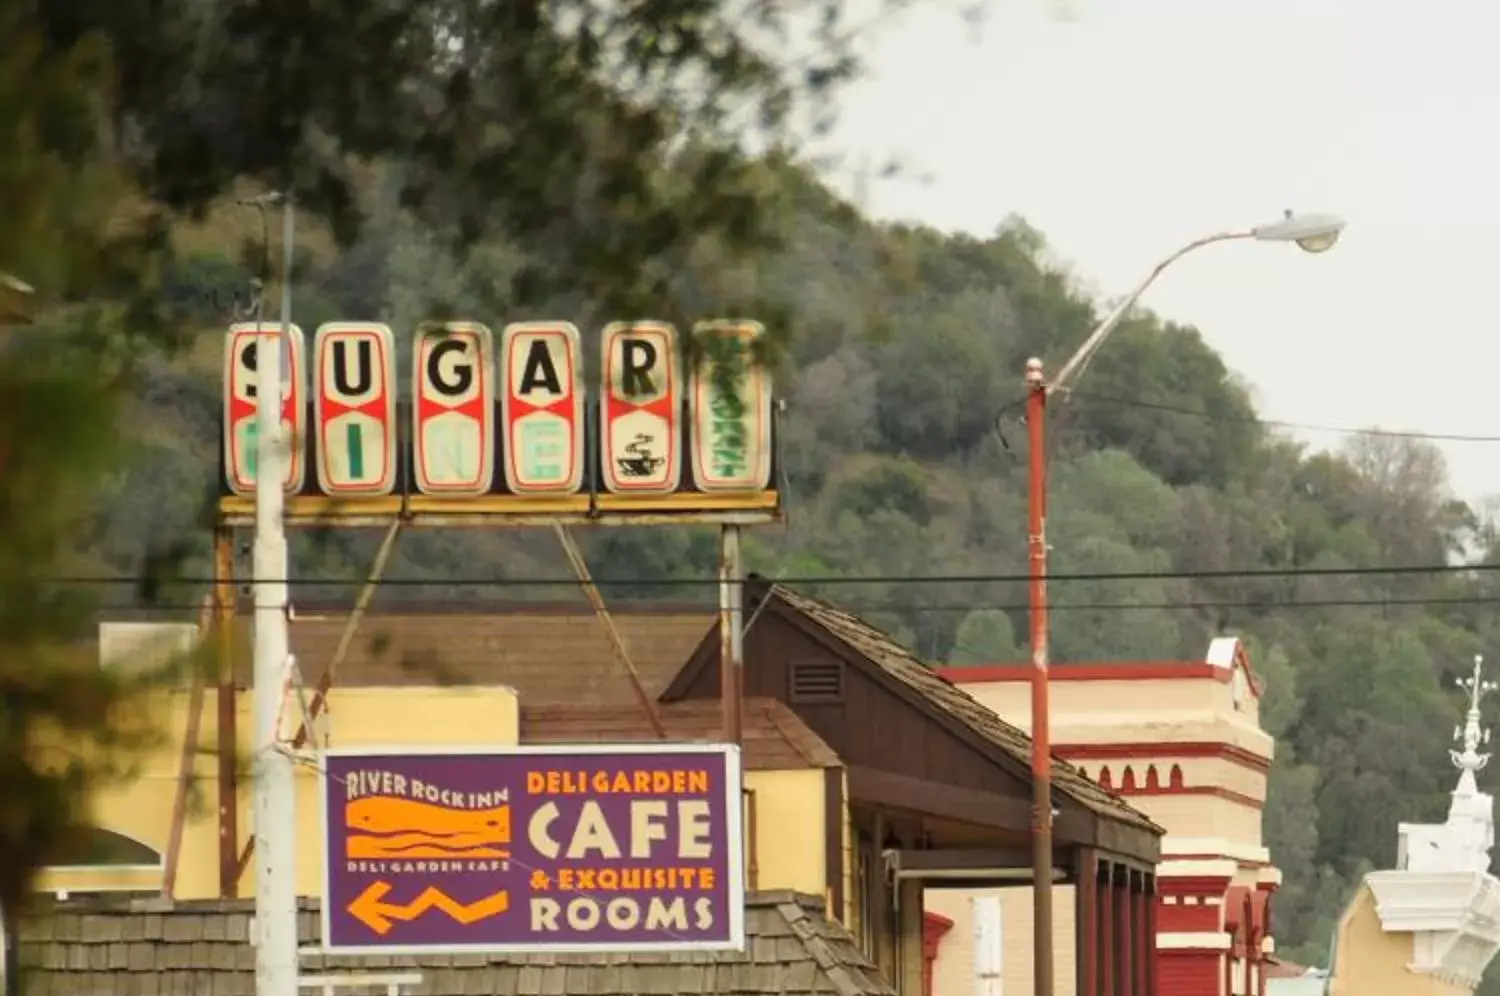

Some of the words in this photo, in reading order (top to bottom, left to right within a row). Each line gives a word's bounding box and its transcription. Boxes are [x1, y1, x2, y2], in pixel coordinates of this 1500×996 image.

[346, 768, 407, 800] RIVER
[411, 779, 464, 808] ROCK
[469, 788, 509, 809] INN
[527, 771, 588, 794] DELI
[590, 770, 708, 794] GARDEN
[528, 800, 713, 860] CAFE
[347, 861, 386, 873] DELI
[390, 861, 462, 873] GARDEN
[468, 861, 510, 872] CAFE
[530, 869, 551, 890] &
[558, 867, 714, 890] EXQUISITE
[530, 896, 714, 931] ROOMS
